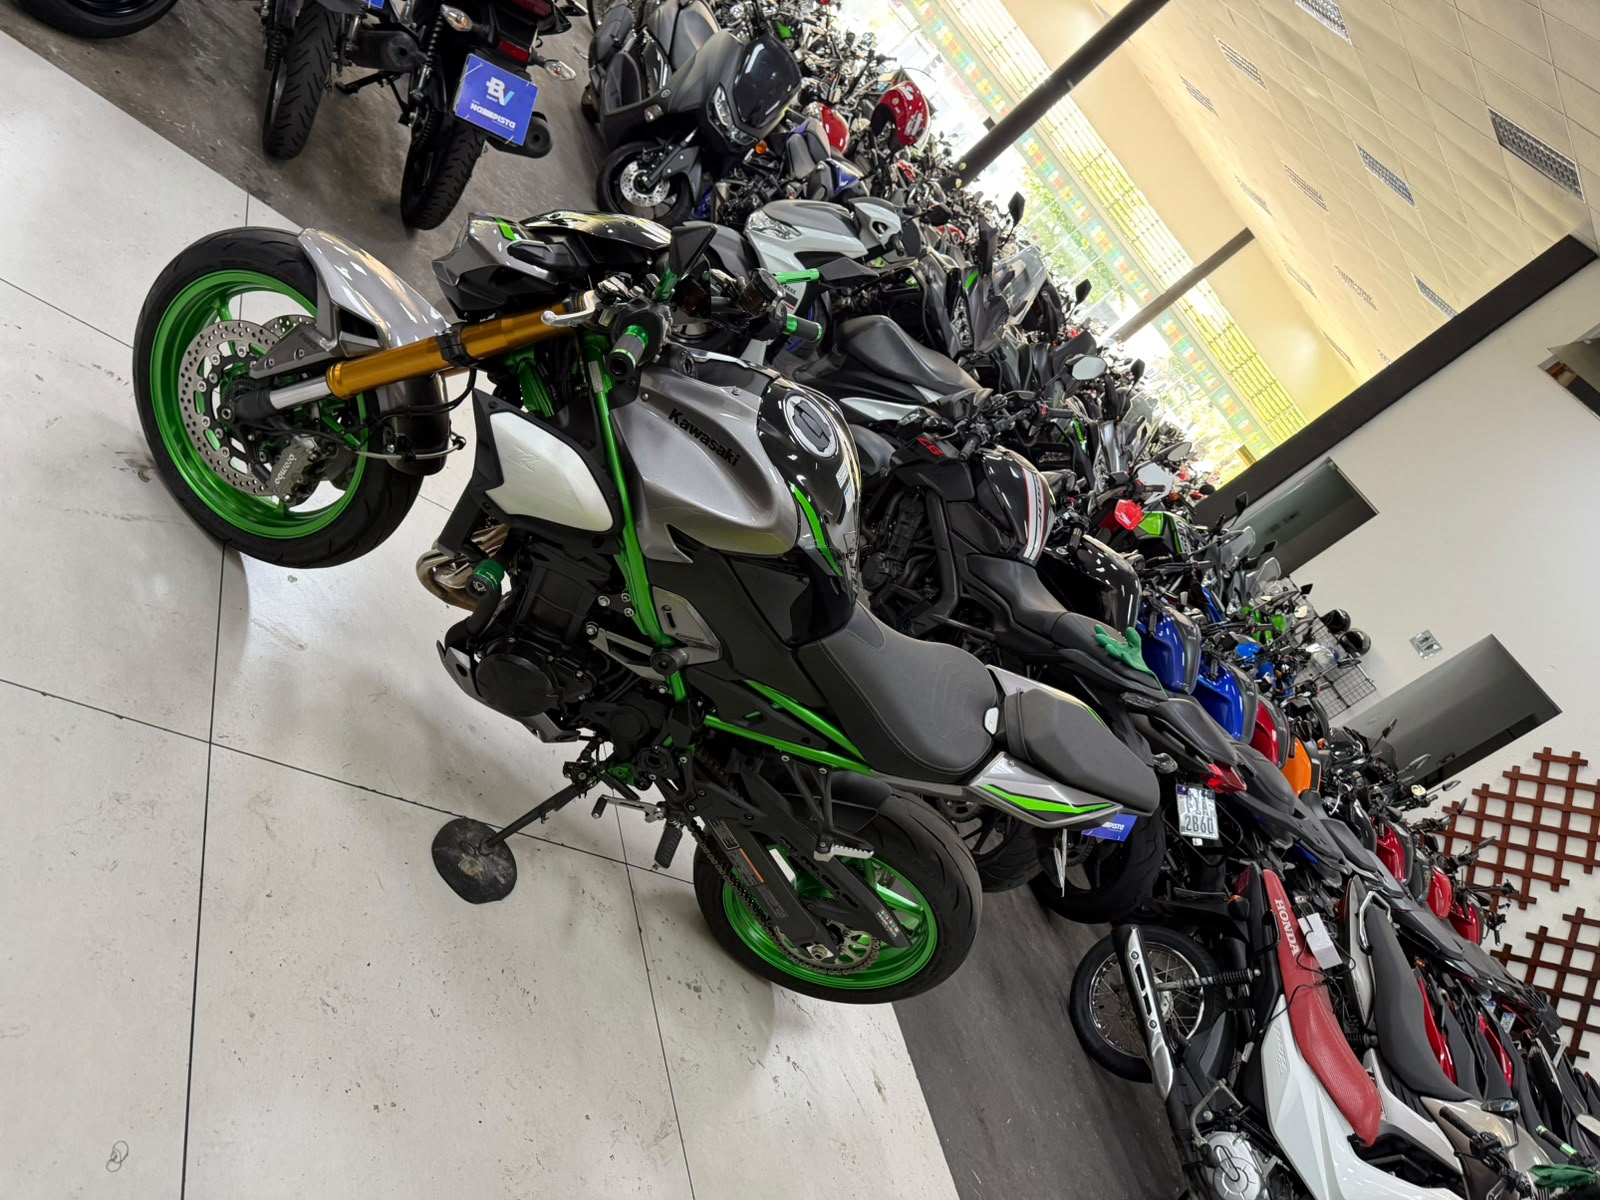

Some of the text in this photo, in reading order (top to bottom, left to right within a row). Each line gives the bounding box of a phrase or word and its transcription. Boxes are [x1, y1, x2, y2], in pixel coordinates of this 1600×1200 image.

[668, 408, 741, 467] Kawasaki
[274, 453, 297, 485] brembo
[1274, 899, 1300, 957] HONDA
